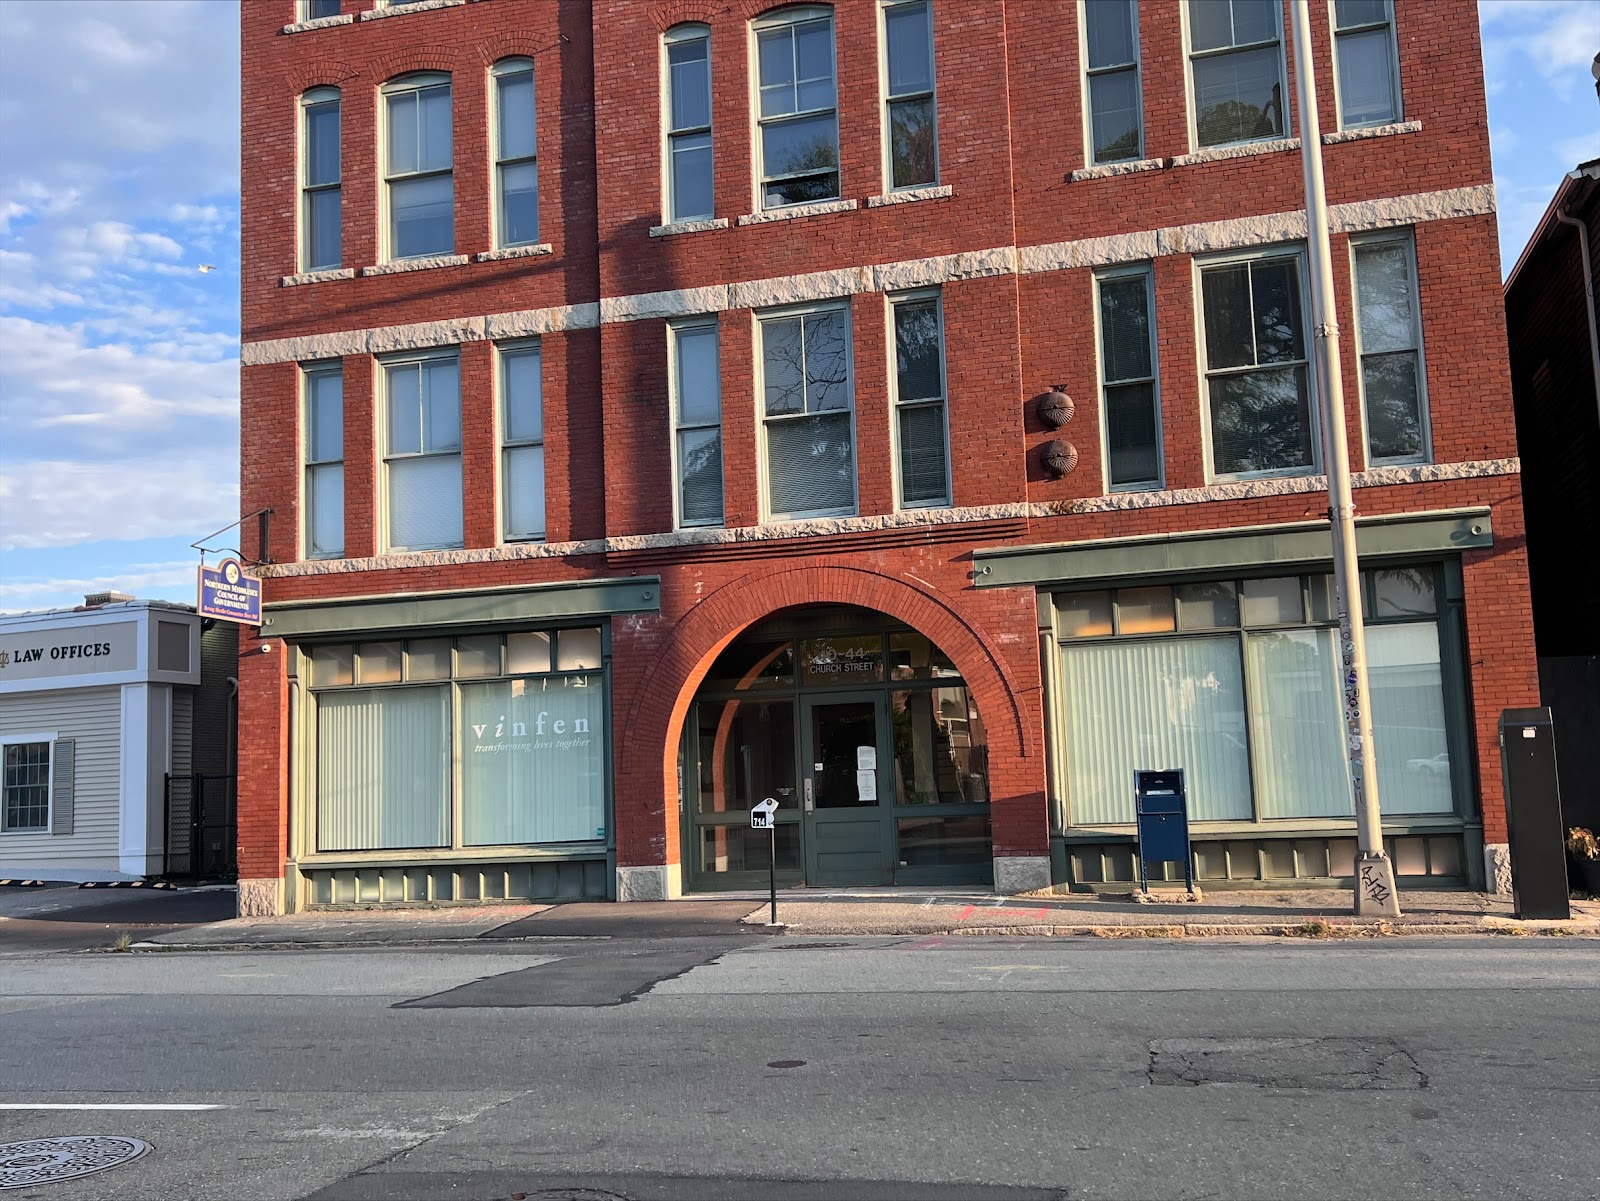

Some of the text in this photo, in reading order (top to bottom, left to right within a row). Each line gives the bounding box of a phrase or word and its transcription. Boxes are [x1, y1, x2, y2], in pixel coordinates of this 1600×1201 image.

[14, 643, 111, 663] LAW OFFICES
[810, 661, 874, 674] CHURCH STREET
[472, 711, 590, 739] vinfen
[474, 737, 591, 754] transforming lives together
[753, 817, 765, 826] 714
